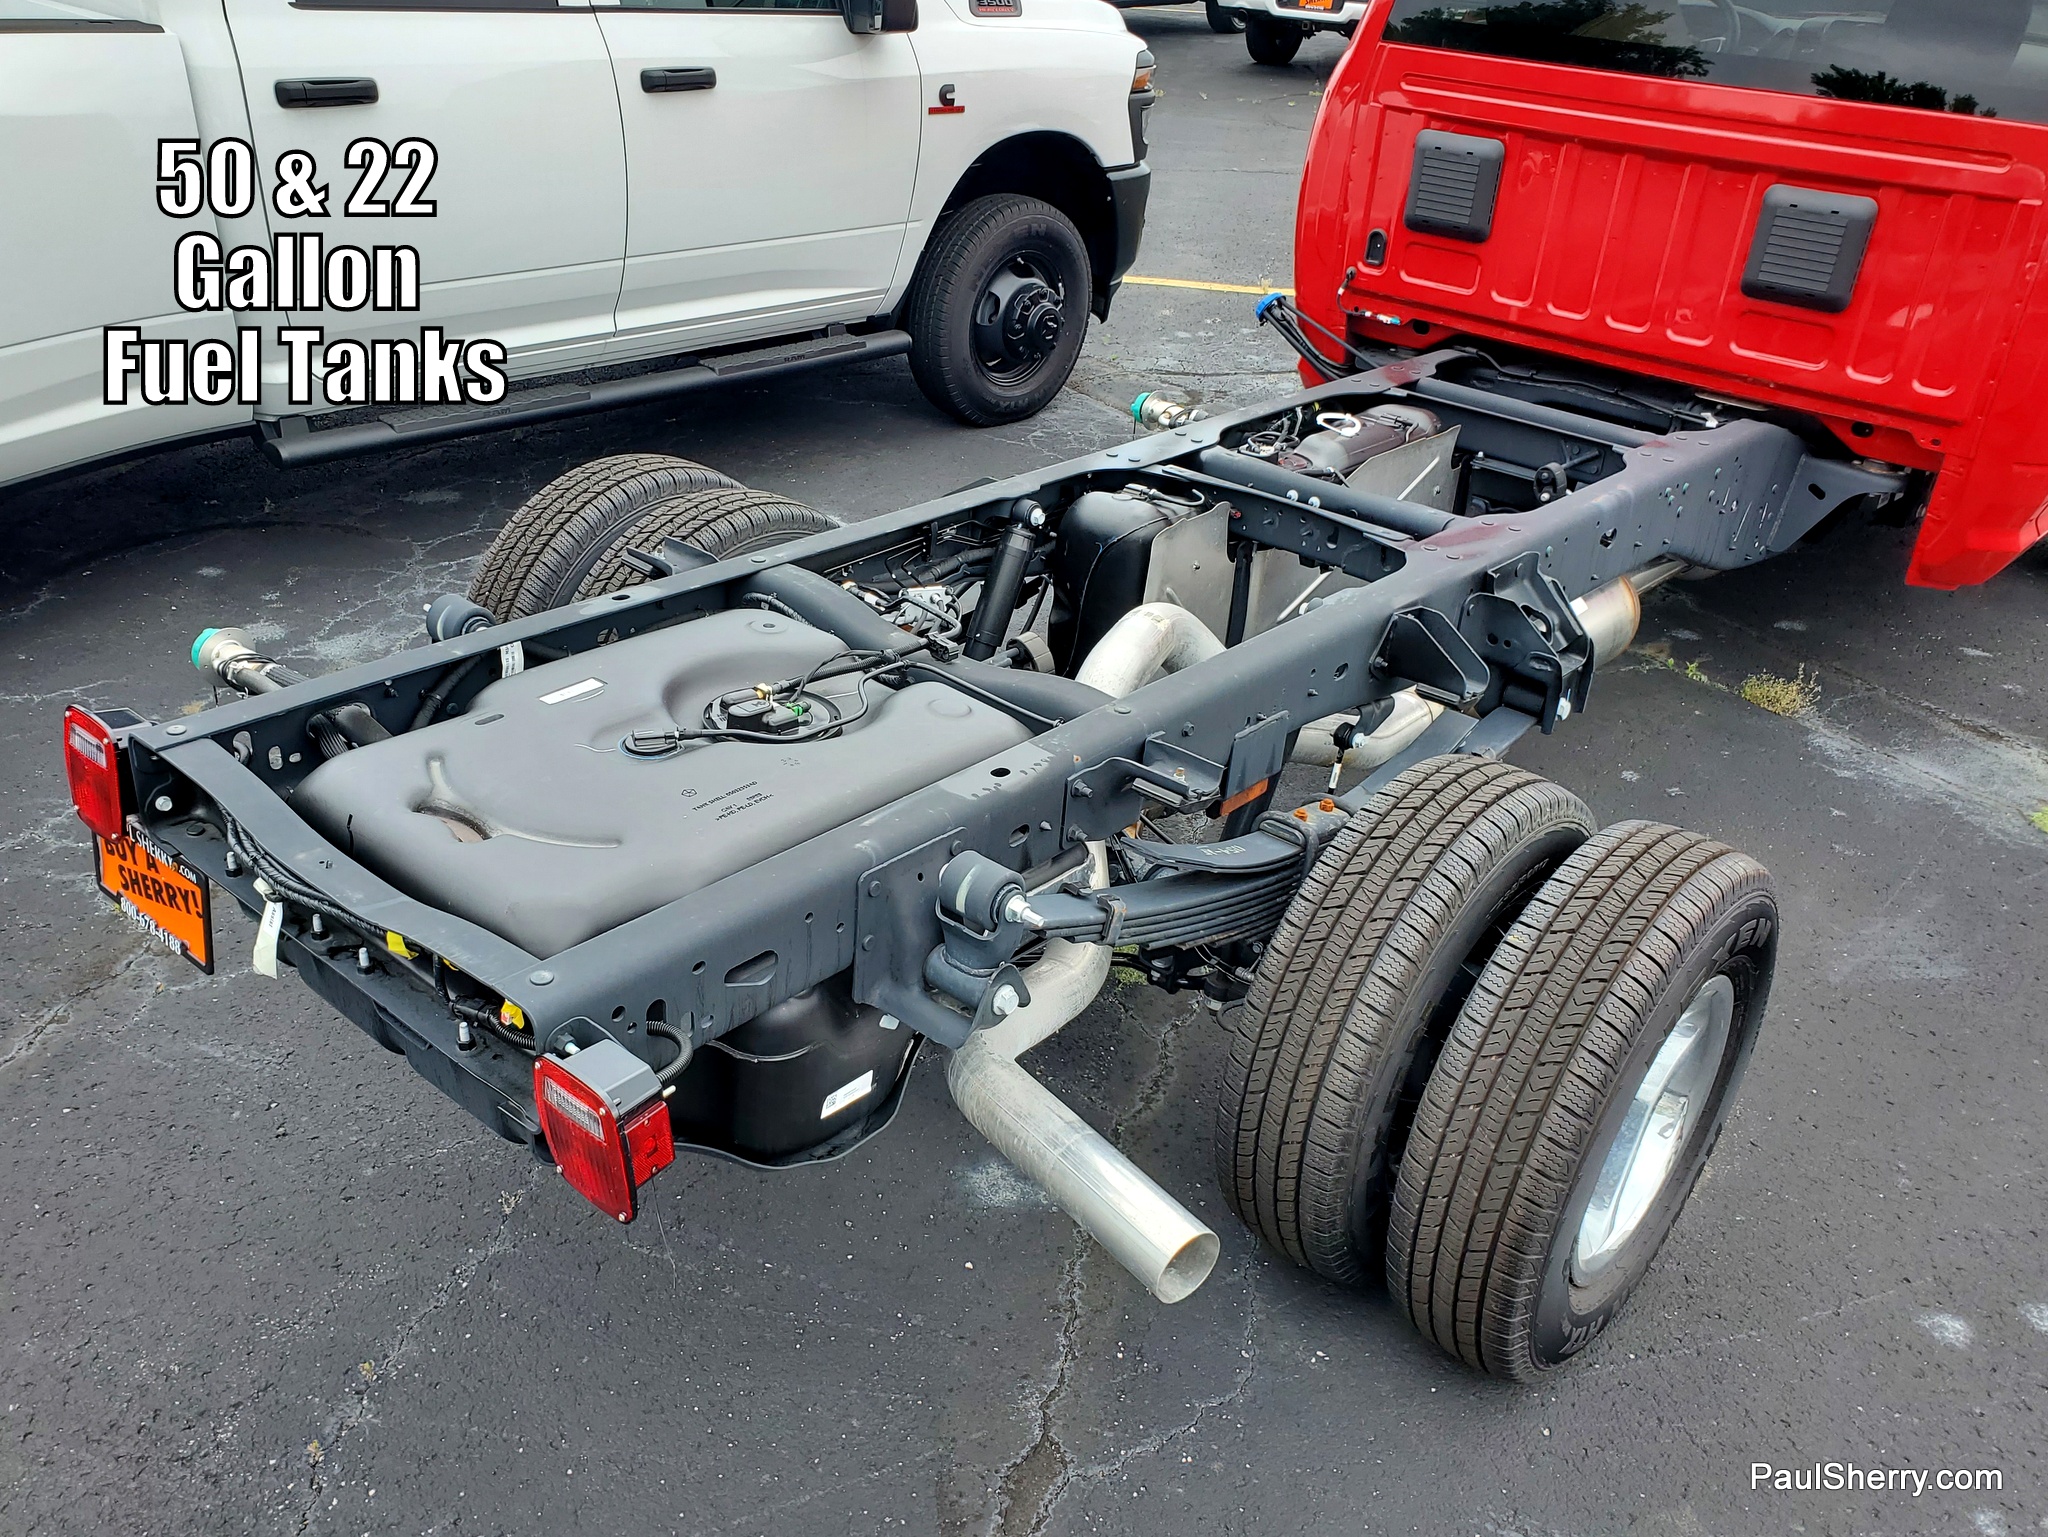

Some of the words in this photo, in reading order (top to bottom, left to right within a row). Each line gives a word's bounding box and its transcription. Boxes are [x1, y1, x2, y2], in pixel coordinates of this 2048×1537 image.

[118, 864, 204, 919] SHERRY!
[146, 853, 160, 875] A
[120, 896, 182, 956] 800-678-4188
